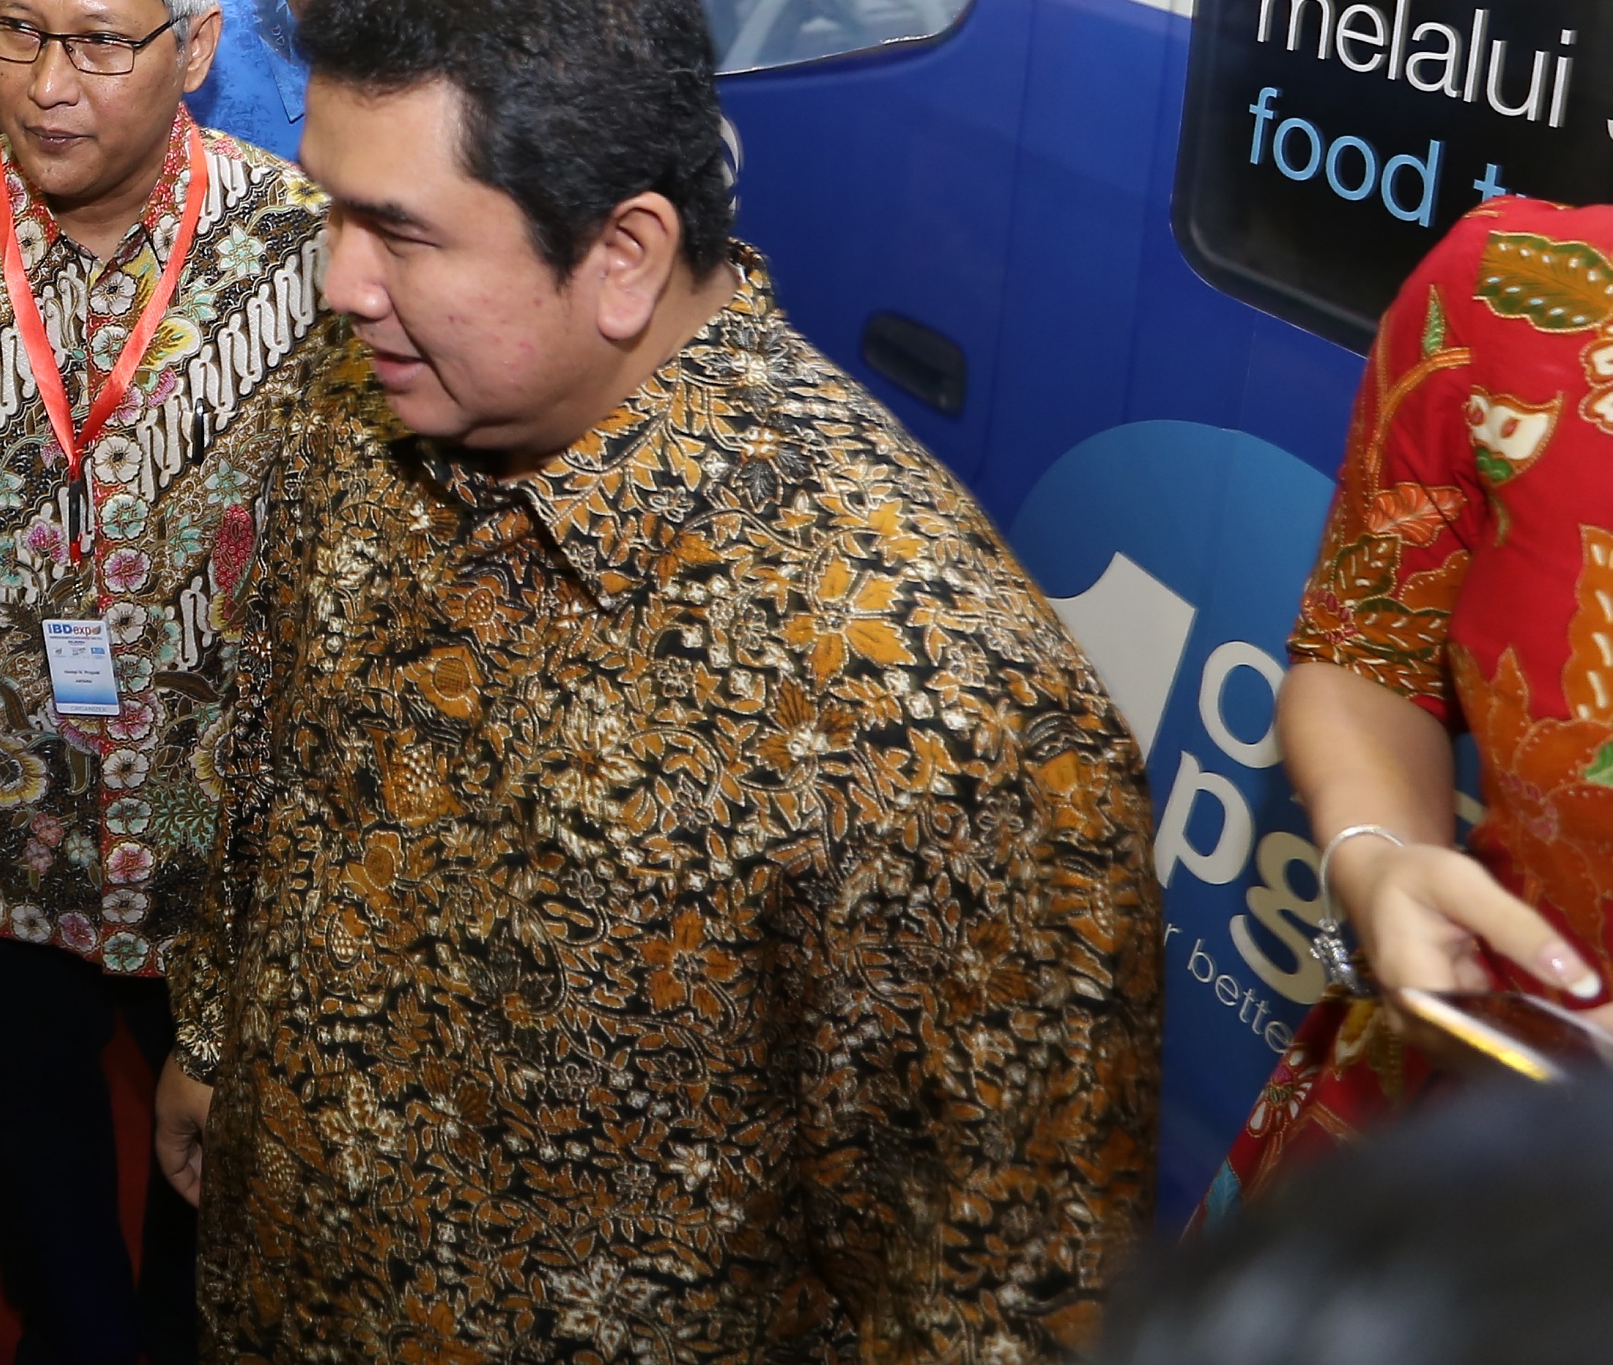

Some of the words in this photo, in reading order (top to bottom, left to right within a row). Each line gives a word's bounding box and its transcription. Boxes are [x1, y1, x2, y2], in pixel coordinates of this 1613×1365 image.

[1247, 87, 1442, 228] food
[1154, 750, 1348, 1005] pg
[1187, 938, 1292, 1054] bette
